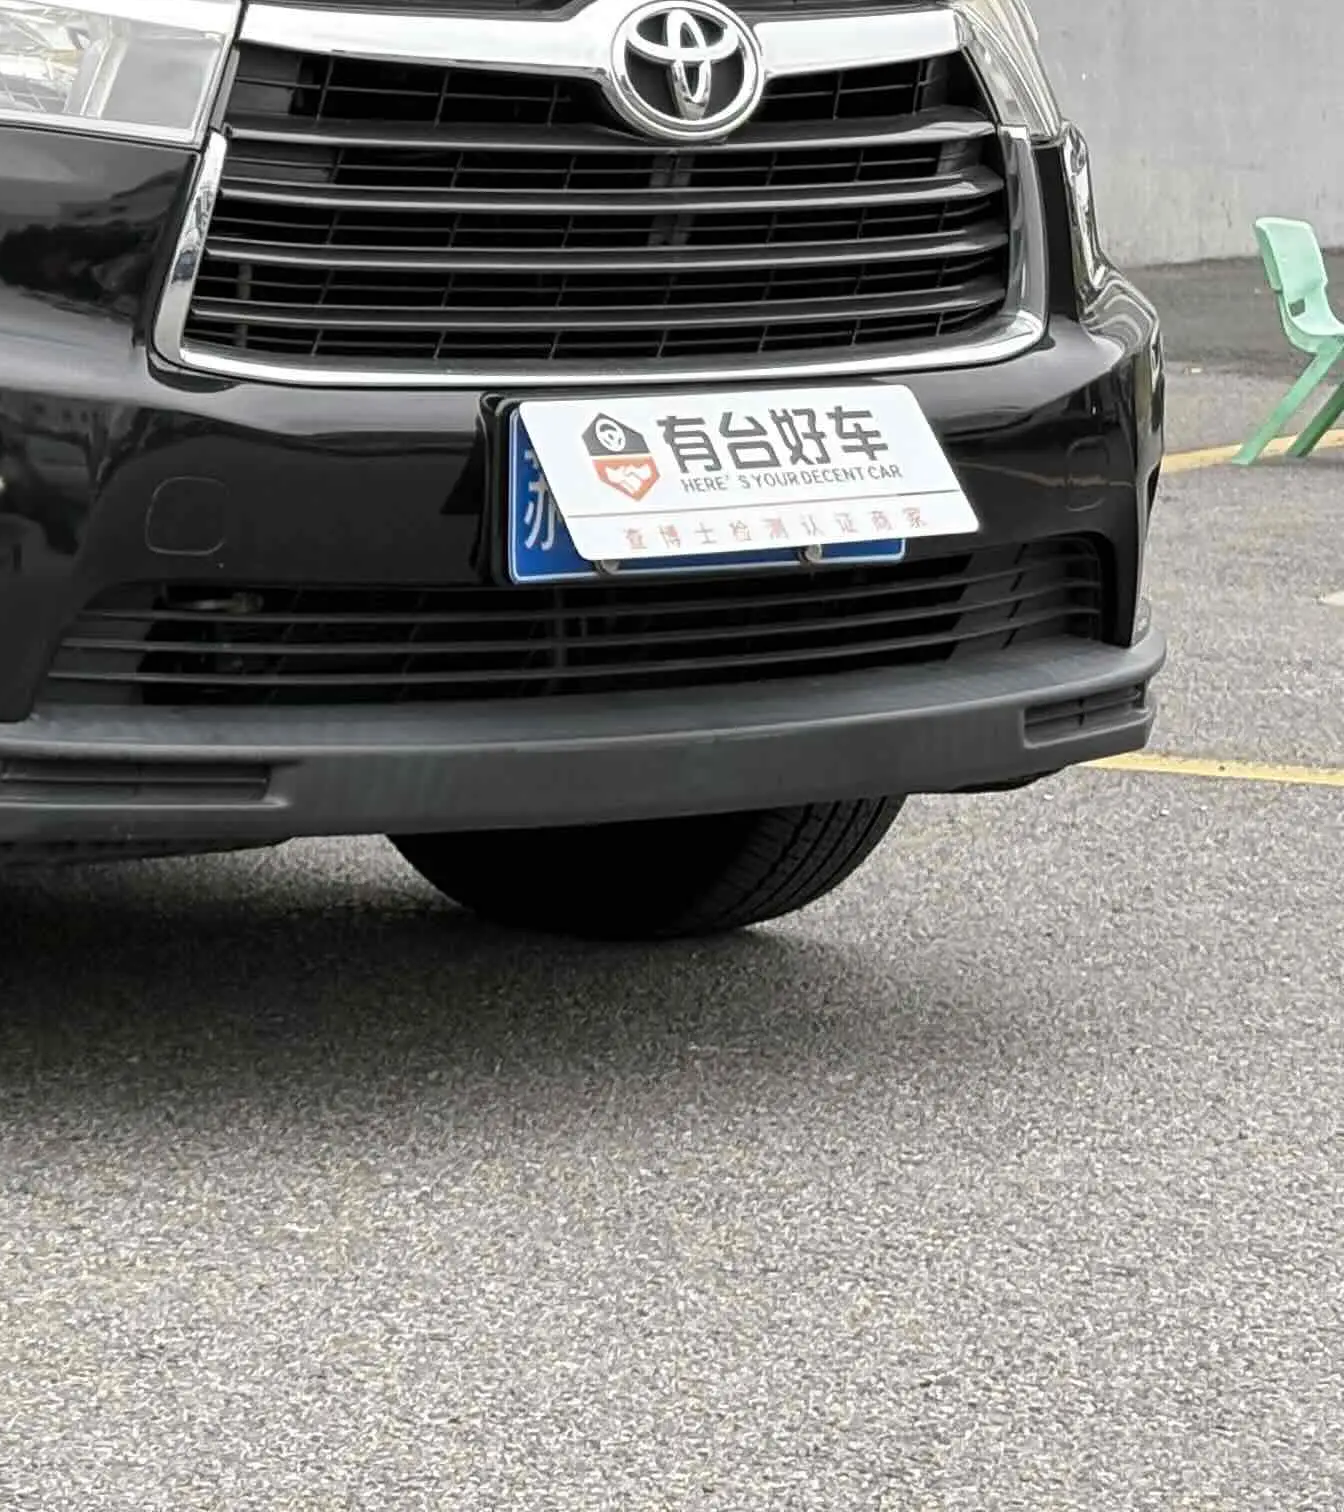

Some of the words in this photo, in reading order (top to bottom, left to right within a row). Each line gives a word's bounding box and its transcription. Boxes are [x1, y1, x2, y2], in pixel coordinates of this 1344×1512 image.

[657, 405, 890, 473] 有台好车
[751, 471, 799, 488] YOUR
[800, 467, 866, 485] DECENT
[868, 463, 904, 480] CAR
